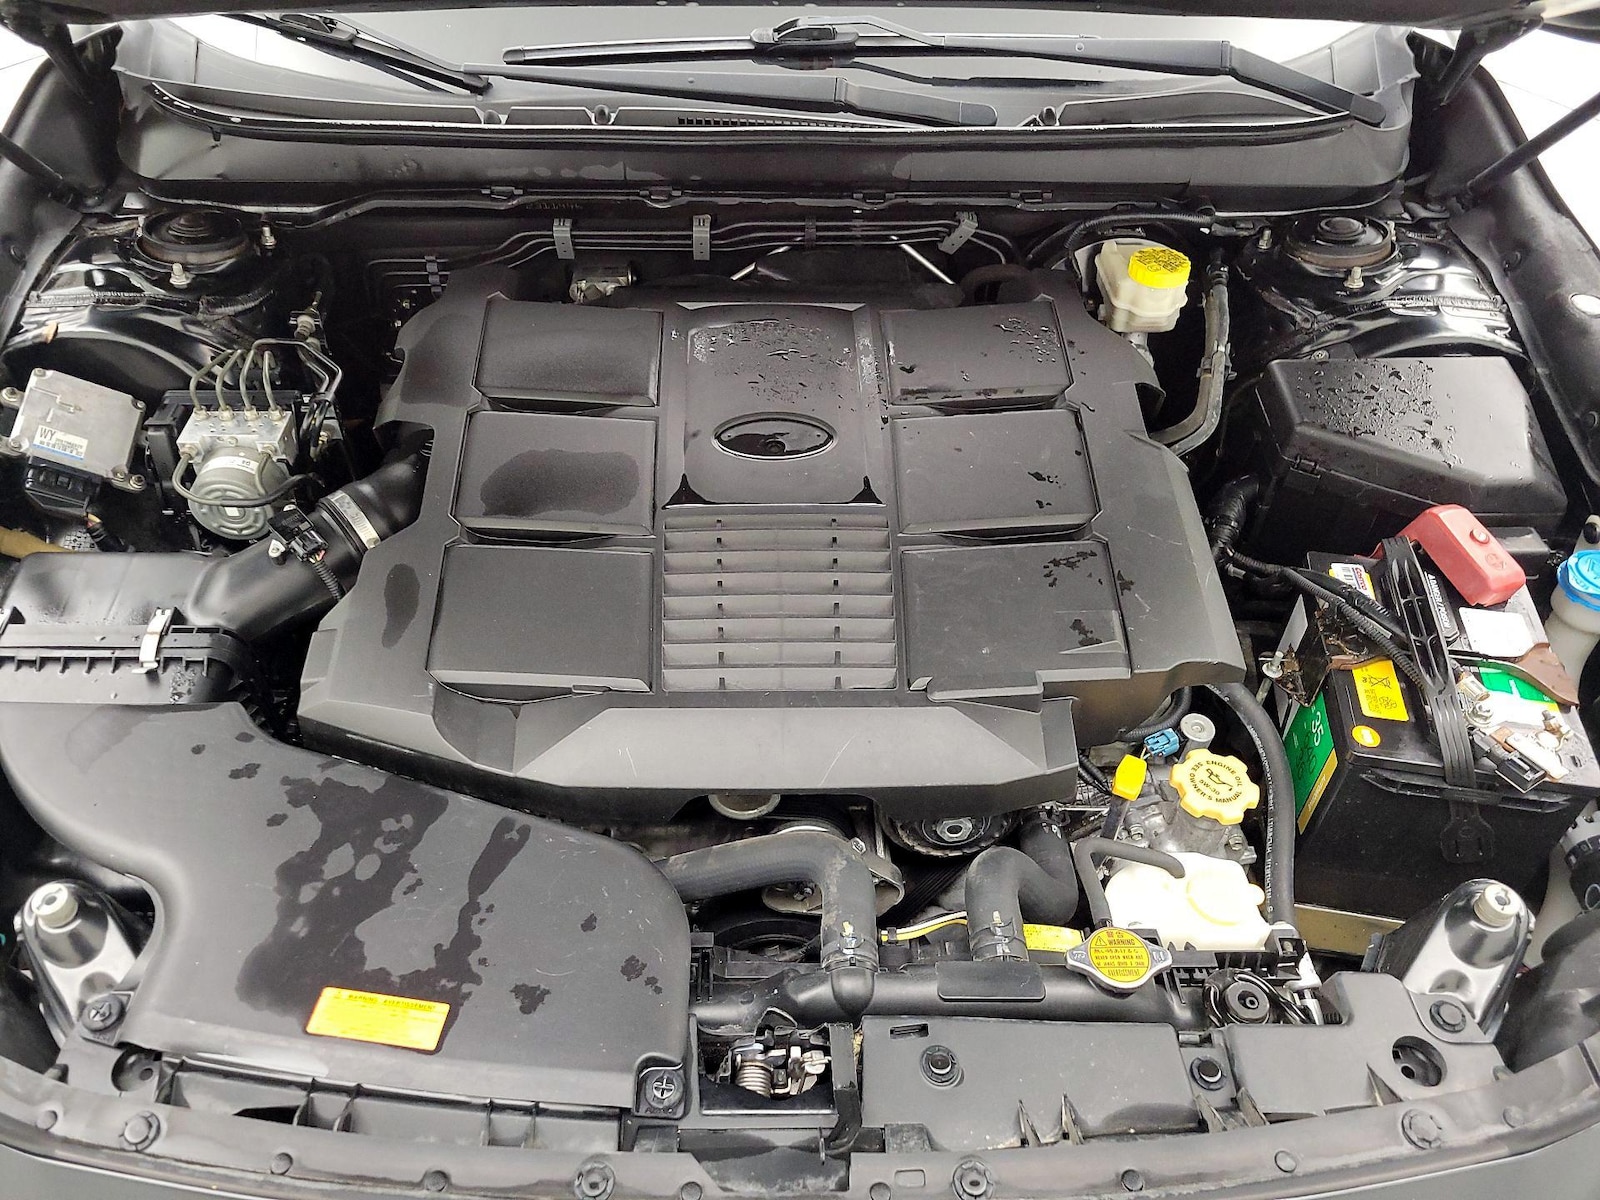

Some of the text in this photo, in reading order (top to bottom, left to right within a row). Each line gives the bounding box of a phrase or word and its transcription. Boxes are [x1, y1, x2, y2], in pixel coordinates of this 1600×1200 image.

[40, 427, 56, 440] WY
[1311, 711, 1324, 747] 35
[1189, 761, 1242, 803] SEE OWNER'S MANUAL
[1206, 760, 1243, 787] ENGINE OIL
[1108, 938, 1136, 946] WARNING
